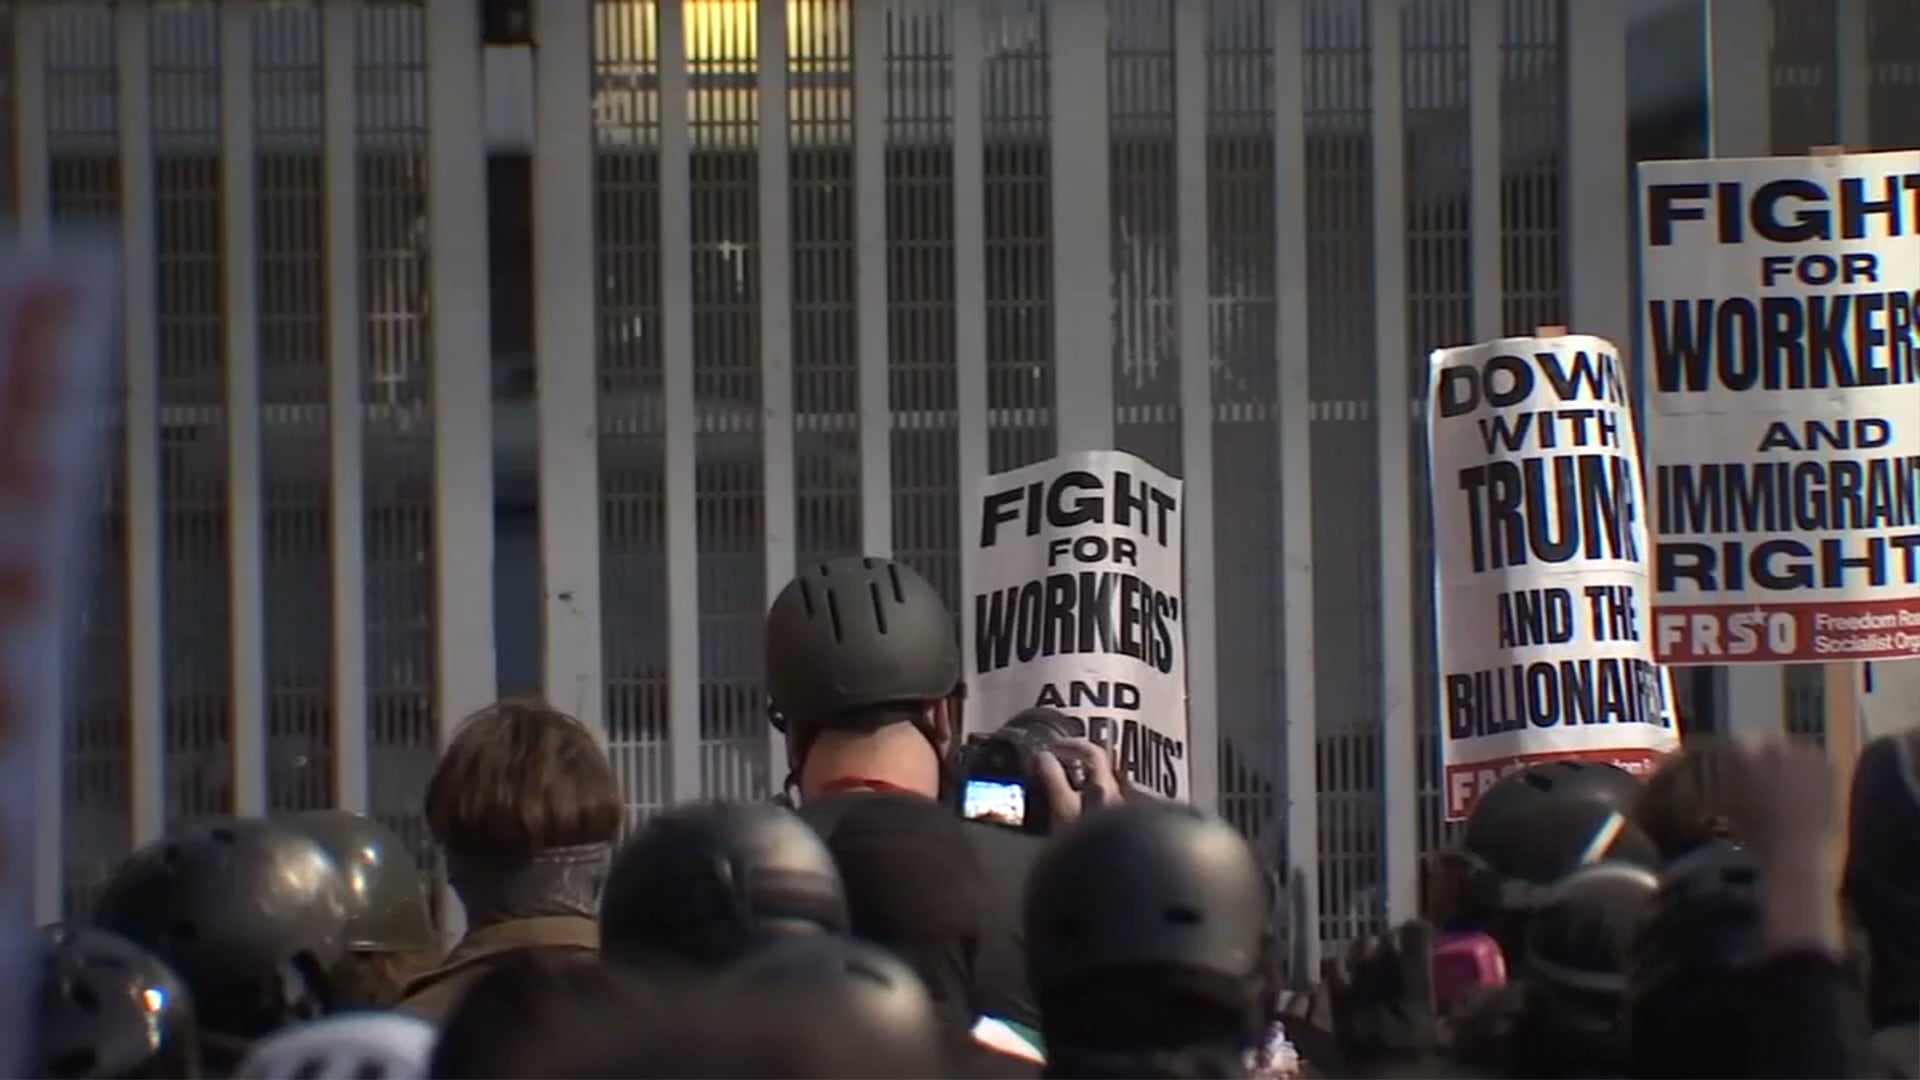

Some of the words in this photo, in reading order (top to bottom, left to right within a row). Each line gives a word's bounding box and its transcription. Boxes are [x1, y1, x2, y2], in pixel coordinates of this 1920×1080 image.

[1761, 253, 1878, 286] FOR
[1440, 351, 1625, 418] DOWN
[1478, 408, 1619, 455] WITH
[1757, 418, 1890, 451] AND
[980, 471, 1176, 548] FIGHT
[1459, 455, 1639, 573] TRUMP
[1656, 456, 1920, 534] IMMIGRAN
[1048, 535, 1138, 567] FOR
[975, 572, 1178, 675] WORKERS'
[1498, 587, 1574, 649] AND
[1584, 585, 1639, 642] THE
[1815, 611, 1897, 631] Freedom
[1814, 634, 1893, 653] Socialist
[1035, 681, 1140, 711] AND
